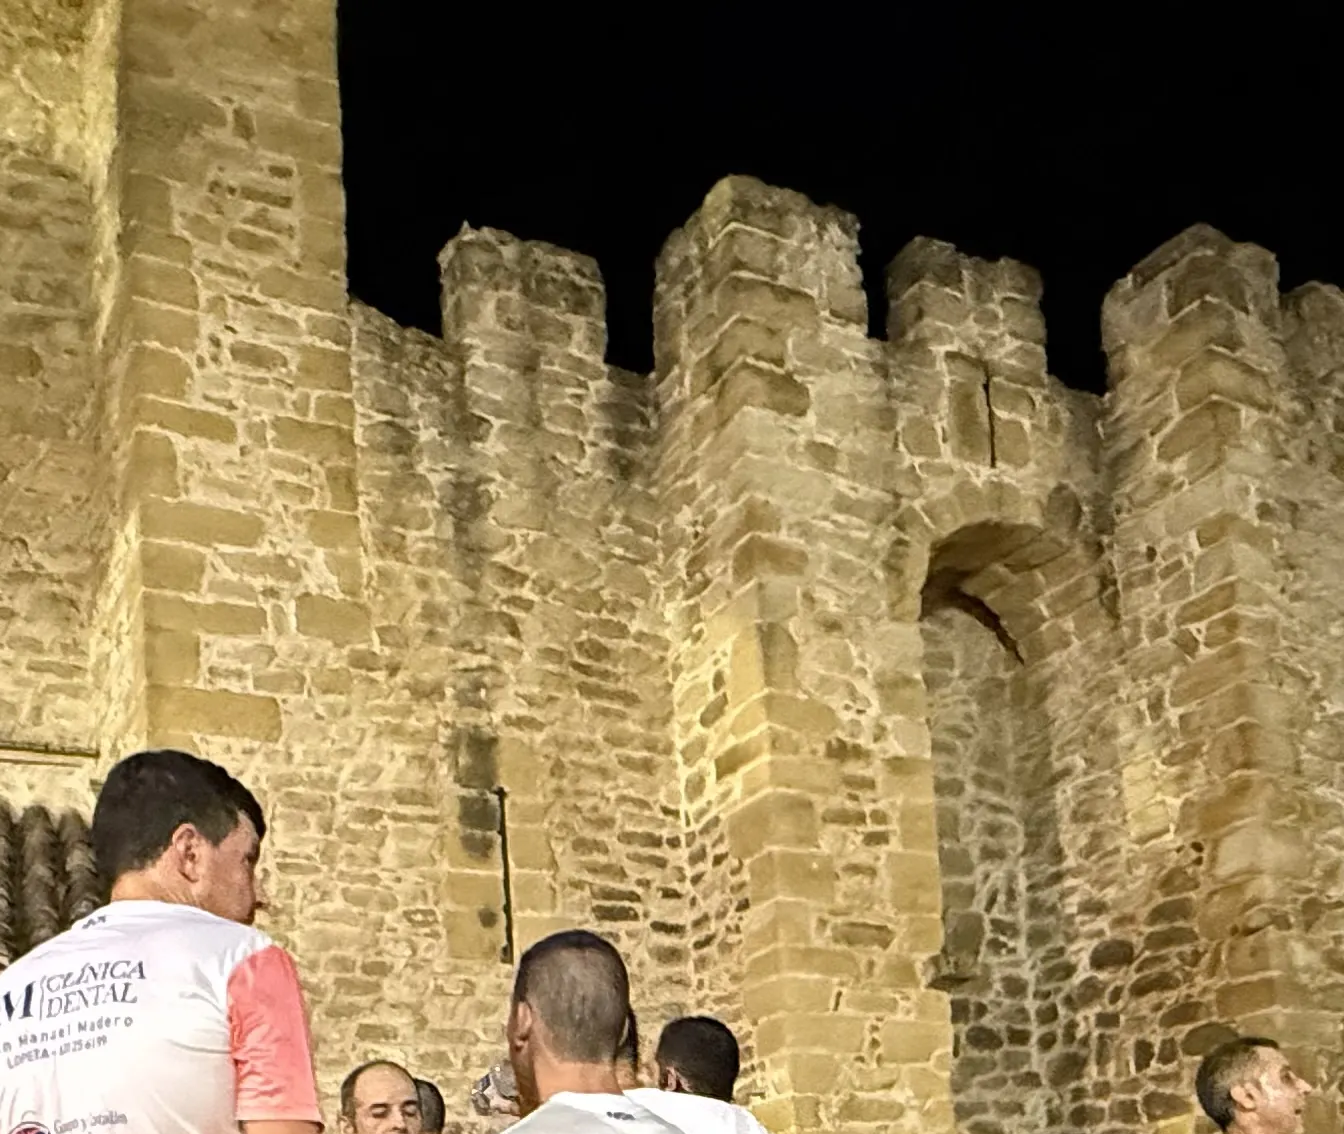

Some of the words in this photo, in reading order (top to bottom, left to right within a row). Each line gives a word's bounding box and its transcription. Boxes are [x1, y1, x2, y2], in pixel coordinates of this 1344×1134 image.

[46, 960, 147, 993] CLÍNICA
[46, 982, 138, 1018] DENTAL
[18, 1023, 71, 1047] Manuel
[77, 1015, 134, 1034] Madero
